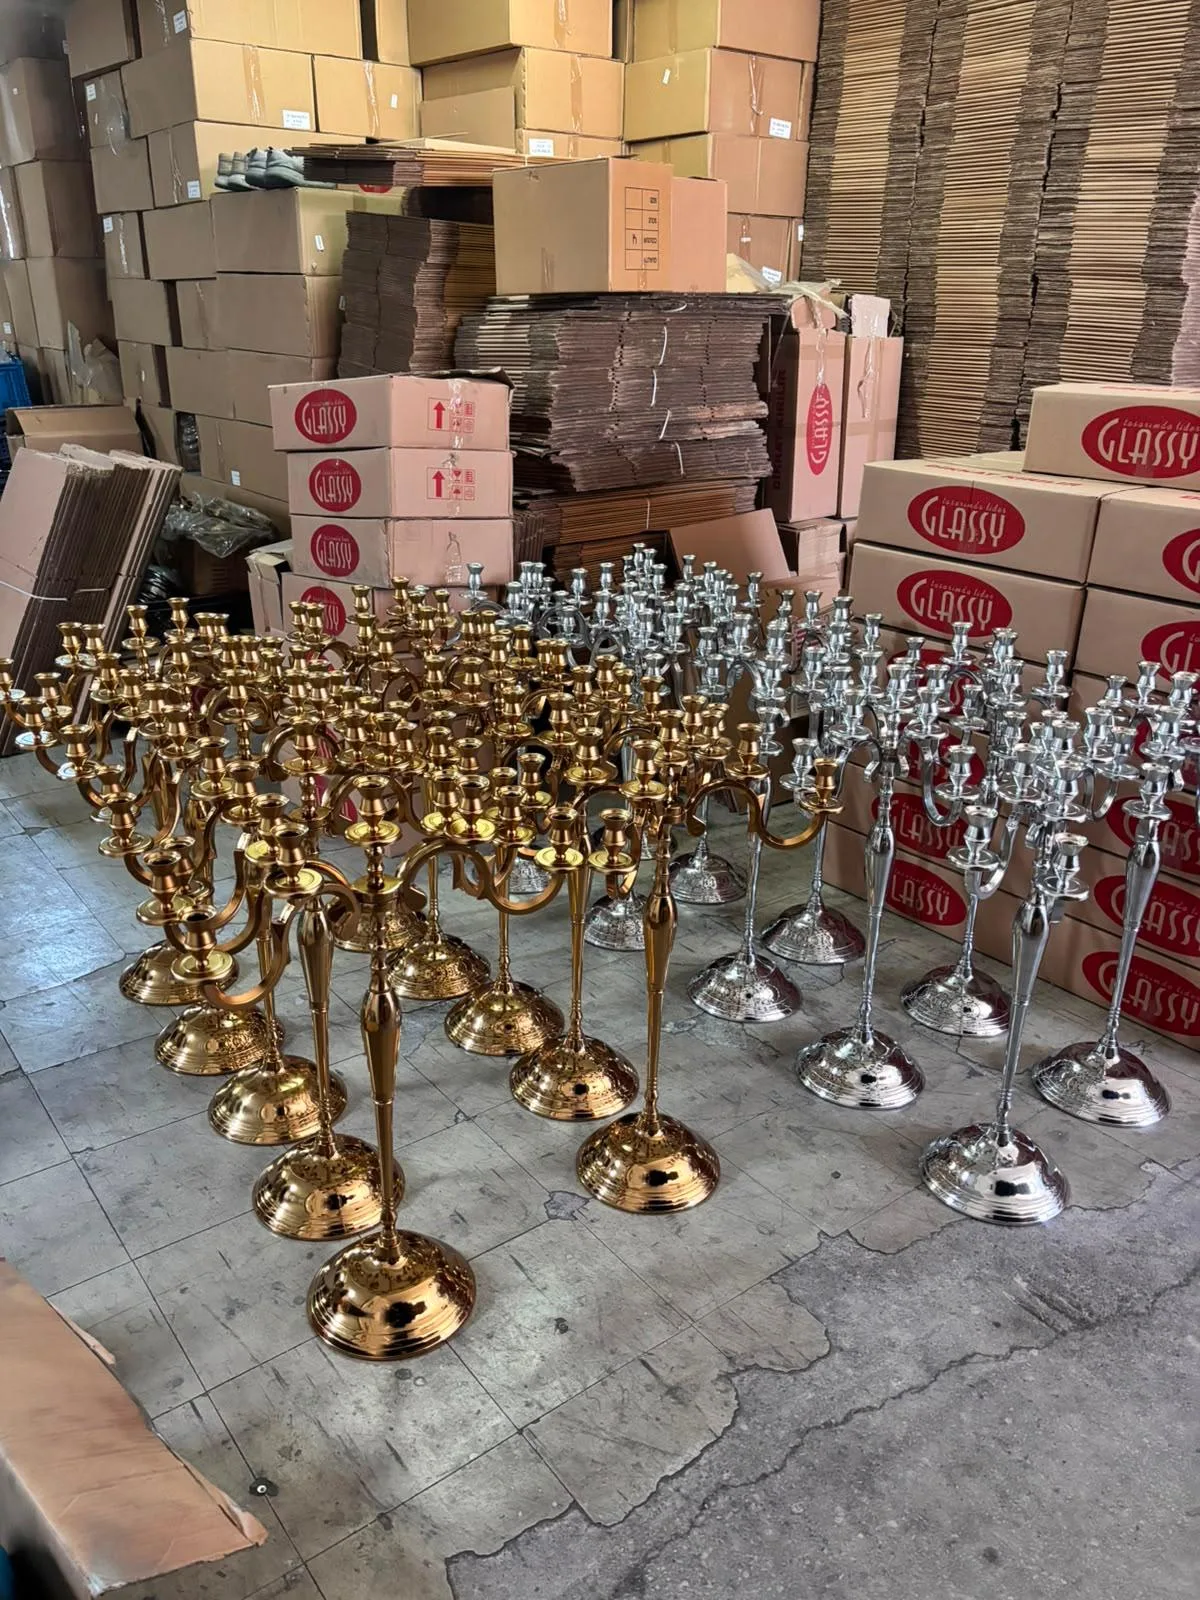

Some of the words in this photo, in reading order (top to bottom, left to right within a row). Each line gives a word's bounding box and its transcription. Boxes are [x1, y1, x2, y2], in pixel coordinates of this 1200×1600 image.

[302, 401, 347, 435] GLASSY
[810, 398, 829, 464] GLASSY
[1097, 417, 1199, 470] GLASSY
[315, 469, 353, 503] GLASSY
[921, 495, 1006, 547] GLASSY
[316, 533, 351, 569] GLASSY
[910, 578, 993, 631] GLASSY
[891, 874, 950, 921] LASSY
